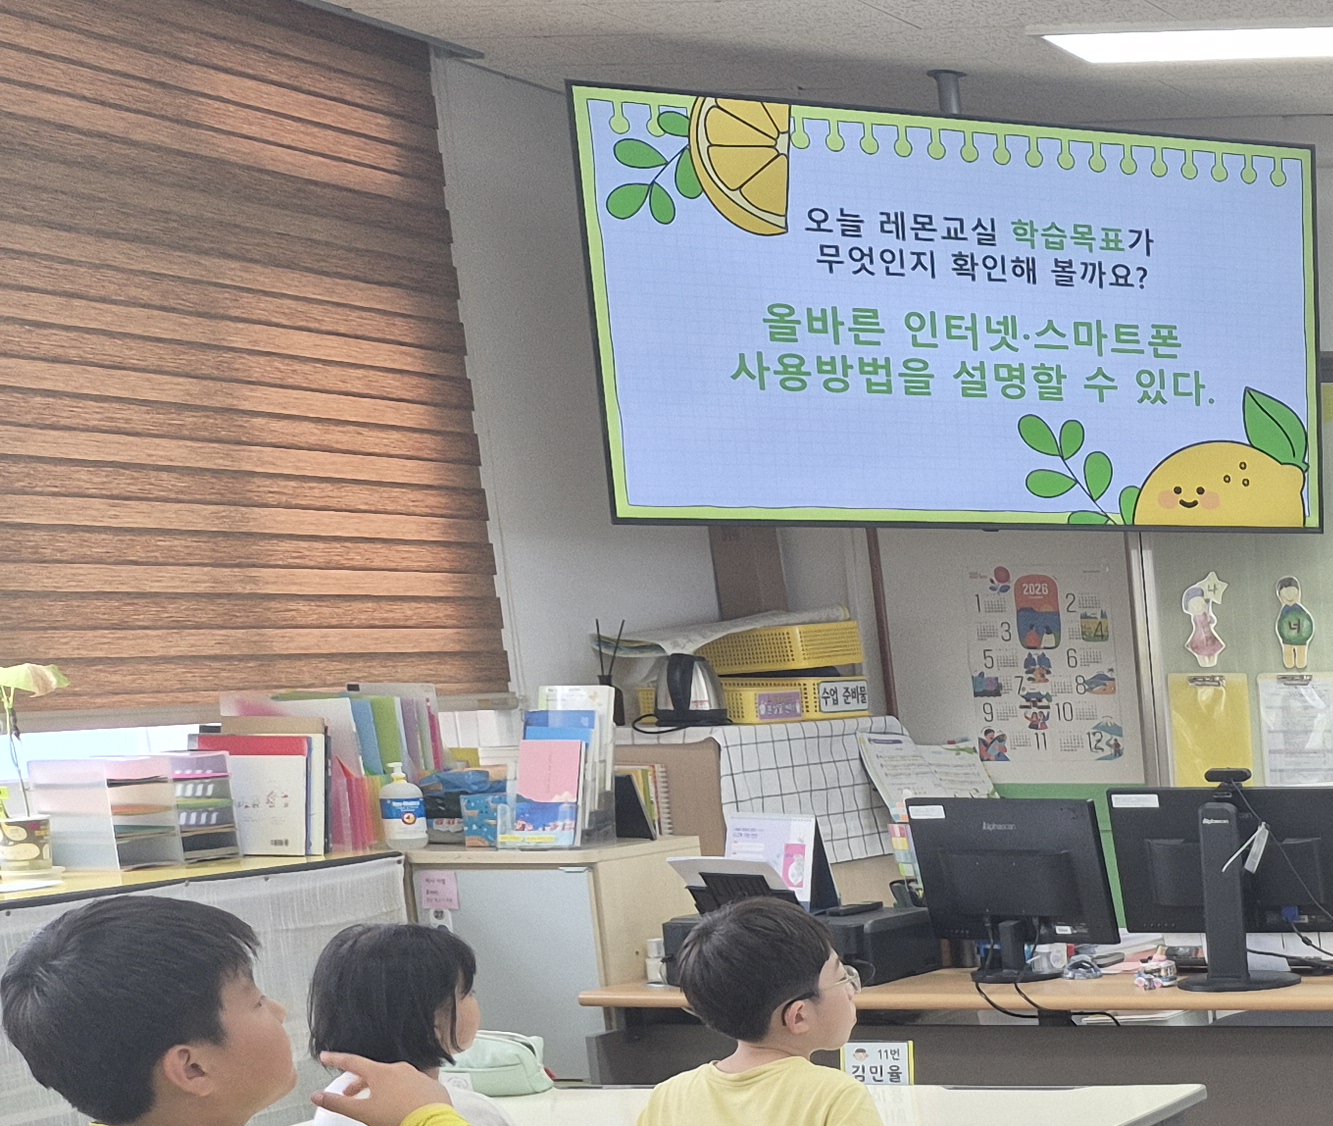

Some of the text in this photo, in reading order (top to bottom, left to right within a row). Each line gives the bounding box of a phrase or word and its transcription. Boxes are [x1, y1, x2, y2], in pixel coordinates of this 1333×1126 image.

[805, 207, 1155, 259] 오늘 레몬교실 학습목표가
[816, 247, 1149, 291] 무엇인지 확인해 볼까요?
[763, 304, 1182, 360] 올바른 인터넷·스마트폰
[730, 351, 1216, 407] 사용방법을 설명할 수 있다.
[1022, 582, 1048, 596] 2026
[1206, 583, 1219, 597] 나
[974, 593, 983, 614] 1
[1065, 593, 1077, 613] 2
[1000, 621, 1012, 642] 3
[1092, 620, 1105, 640] 4
[1289, 620, 1302, 636] 너
[982, 649, 994, 670] 5
[1066, 648, 1078, 669] 6
[1014, 675, 1025, 696] 7
[1075, 674, 1087, 695] 8
[821, 687, 839, 707] 수업
[842, 685, 868, 705] 준비물
[982, 702, 994, 722] 9
[1055, 701, 1075, 722] 10
[1035, 731, 1047, 750] 11
[1086, 730, 1106, 753] 12
[877, 1047, 901, 1062] 11번
[851, 1064, 903, 1084] 김민율
